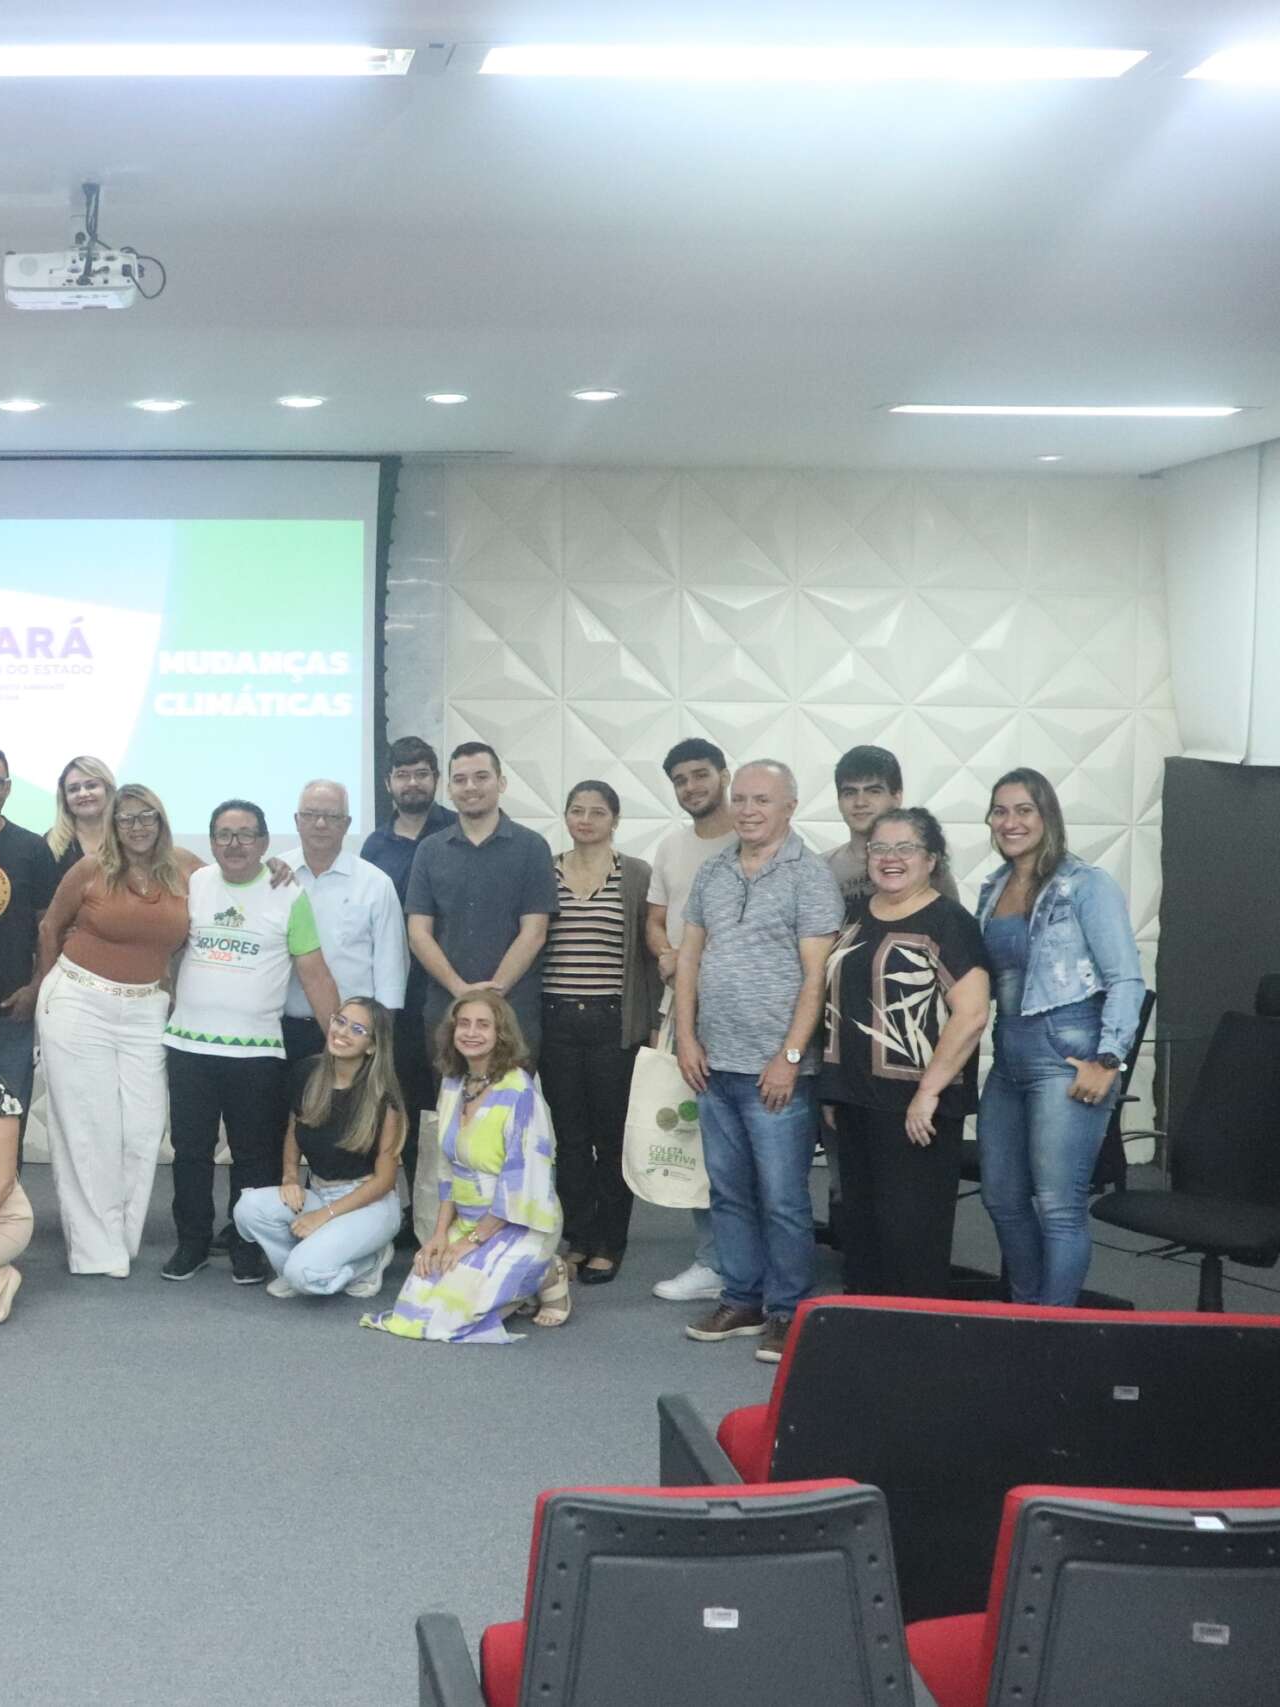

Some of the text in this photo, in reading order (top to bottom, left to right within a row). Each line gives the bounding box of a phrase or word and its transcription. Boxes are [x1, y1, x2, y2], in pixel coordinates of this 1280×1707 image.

[6, 664, 29, 676] DO
[33, 664, 94, 676] ESTADO
[159, 651, 351, 683] MUDANÇAS
[153, 682, 353, 717] CLIMÁTICAS
[649, 1145, 683, 1154] COLETA
